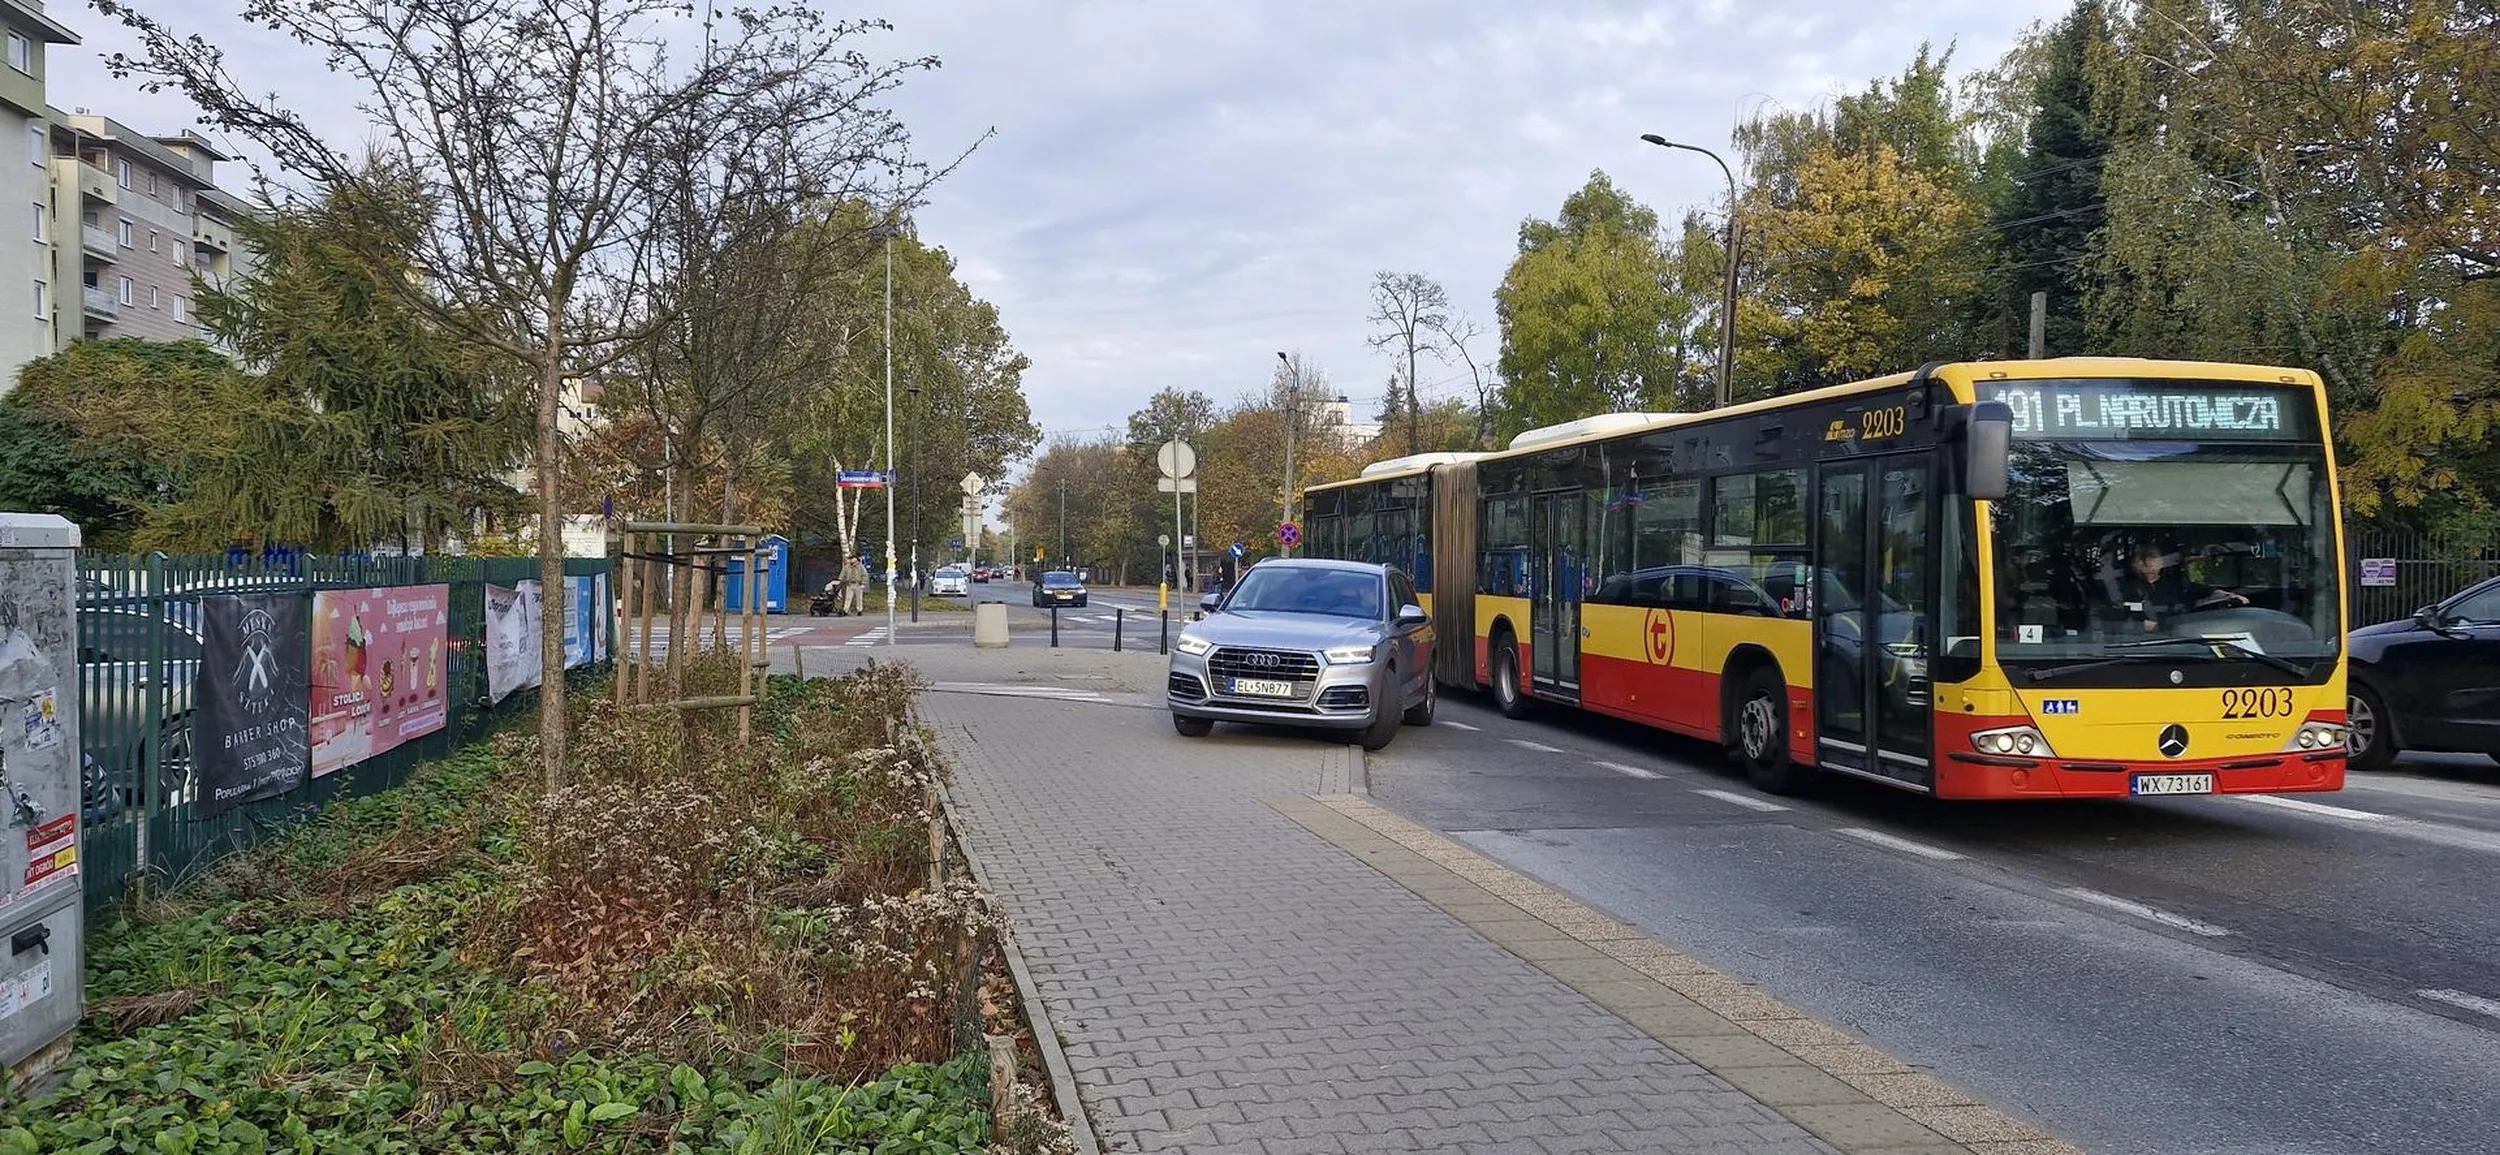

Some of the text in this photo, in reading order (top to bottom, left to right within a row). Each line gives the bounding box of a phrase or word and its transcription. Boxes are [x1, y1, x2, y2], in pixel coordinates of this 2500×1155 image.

[2100, 394, 2280, 430] NARUTOWICZA
[1861, 405, 1905, 440] 2203
[2026, 627, 2034, 640] 4
[1237, 680, 1251, 692] EL
[2222, 687, 2293, 719] 2203
[267, 717, 296, 736] SHOP
[2140, 776, 2210, 793] WX 73161
